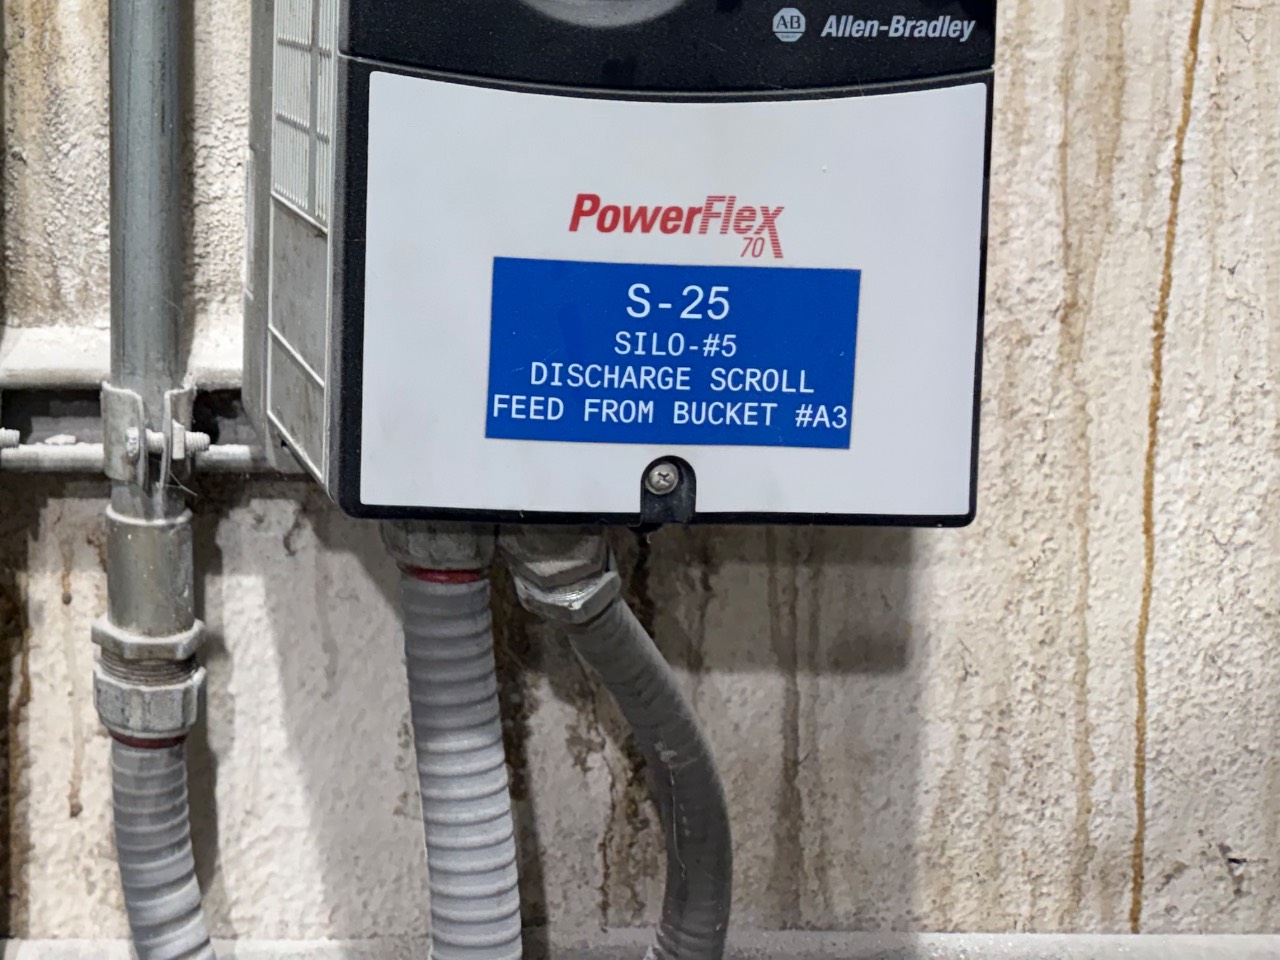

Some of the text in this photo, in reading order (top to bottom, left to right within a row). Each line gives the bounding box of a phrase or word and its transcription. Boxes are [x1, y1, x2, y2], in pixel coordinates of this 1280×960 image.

[820, 15, 976, 43] Allen-Bradley
[569, 194, 784, 258] PowerFlex
[740, 237, 765, 258] 70
[626, 283, 730, 320] S-25
[614, 331, 737, 358] SILO-#5
[530, 361, 815, 394] DISCHARGE SCROLL
[493, 394, 847, 429] FEED FROM BUCKET #A3
